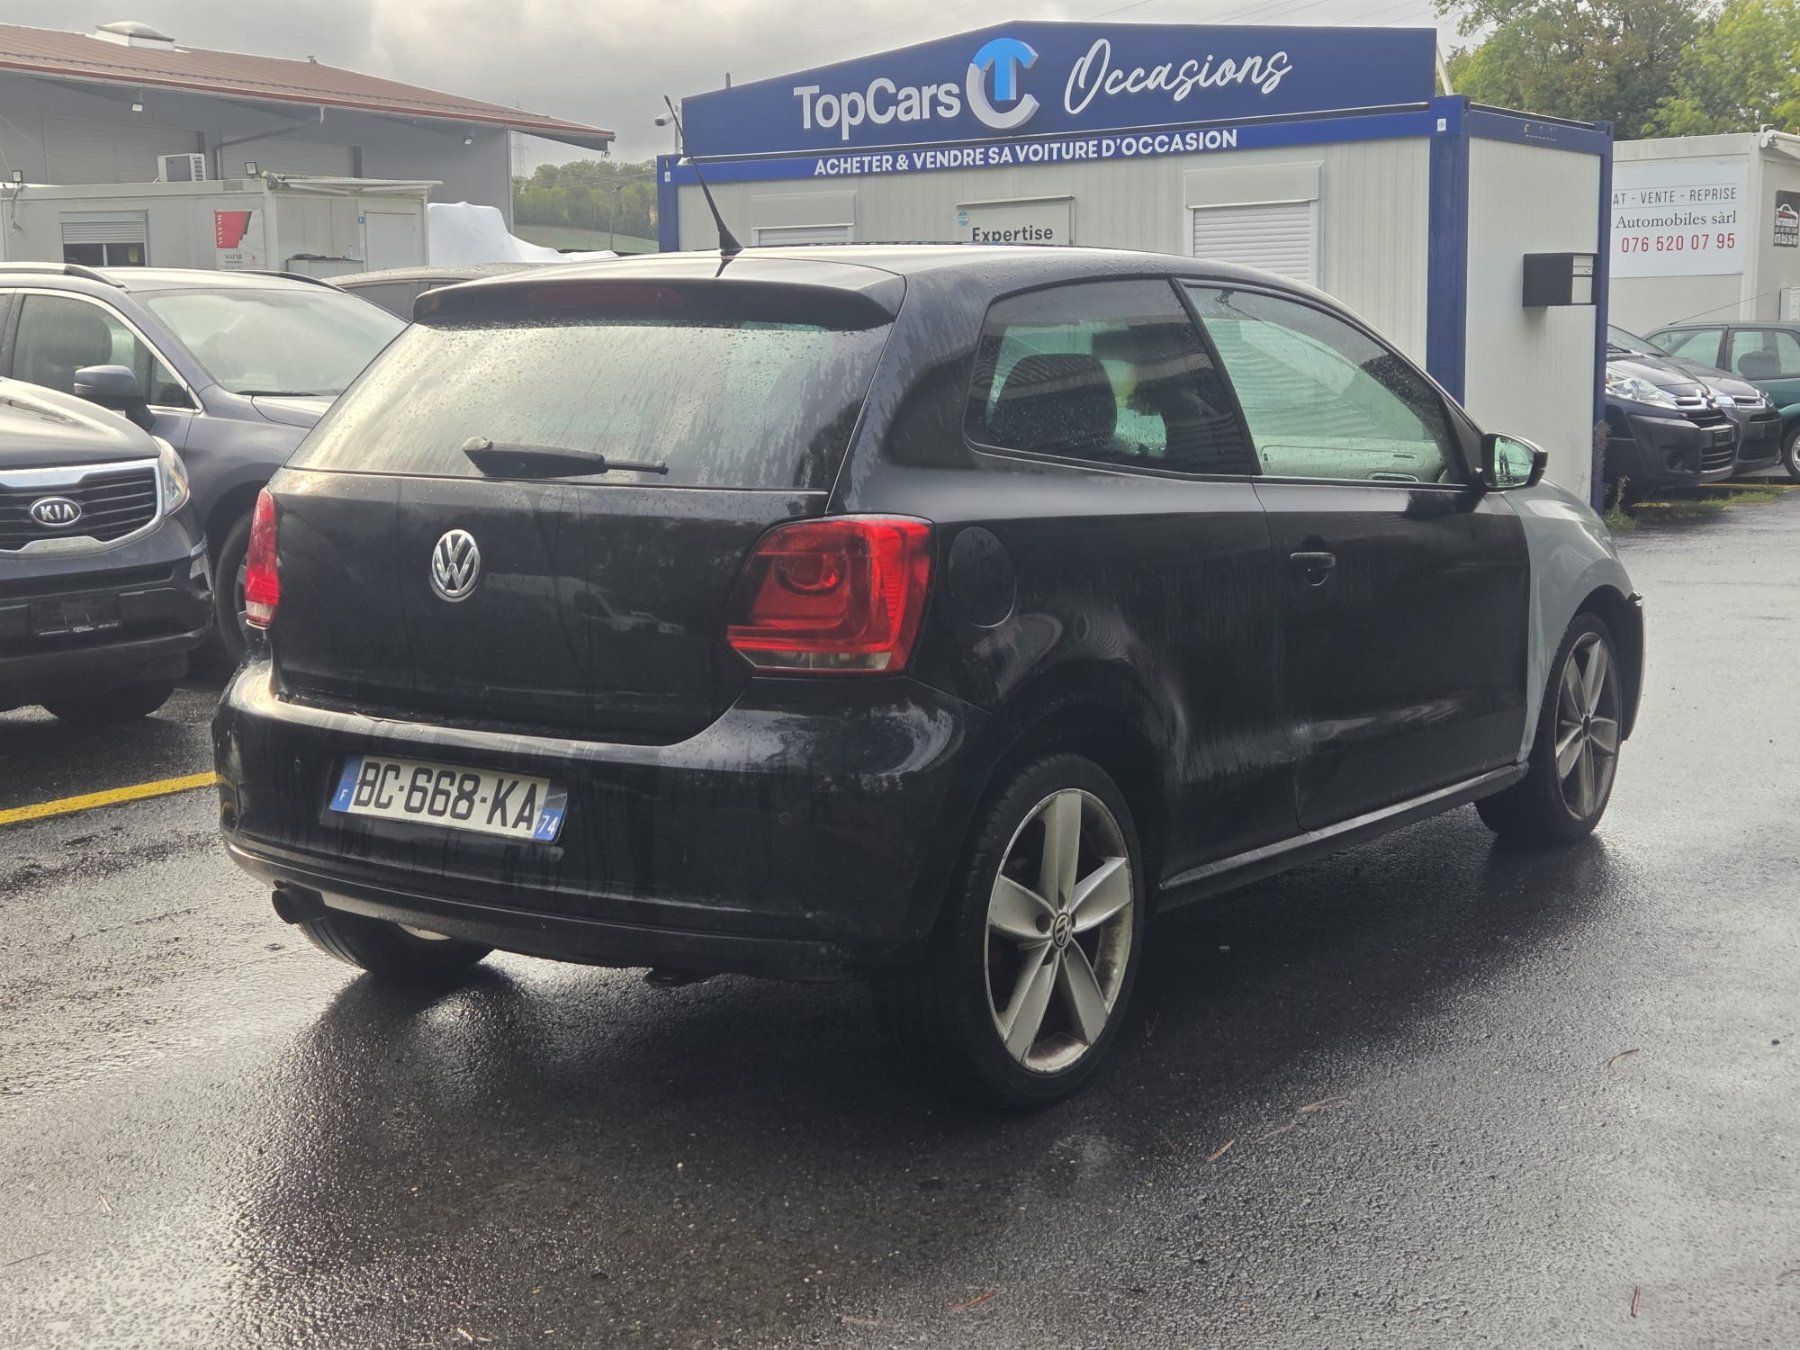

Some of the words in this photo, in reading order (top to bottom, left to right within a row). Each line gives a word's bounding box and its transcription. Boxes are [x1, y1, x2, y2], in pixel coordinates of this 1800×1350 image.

[1064, 38, 1292, 114] Occasions
[793, 77, 961, 141] TopCars
[814, 155, 893, 176] ACHETER
[896, 153, 909, 171] &
[912, 147, 984, 169] VENDRE
[988, 145, 1013, 165] SA
[1015, 140, 1098, 162] VOITURE
[1102, 129, 1238, 157] D'OCCASION
[1613, 193, 1627, 205] AT
[1640, 190, 1676, 204] VENTE
[1690, 187, 1737, 202] REPRISE
[1616, 211, 1707, 229] Automobiles
[972, 225, 1054, 242] Expertise
[1621, 236, 1649, 253] 076
[1656, 235, 1684, 252] 520
[1691, 234, 1710, 250] 07
[1716, 232, 1736, 249] 95
[40, 504, 75, 520] KIA
[339, 788, 348, 802] F
[353, 762, 538, 830] BC-668-KA
[538, 814, 559, 836] 74
